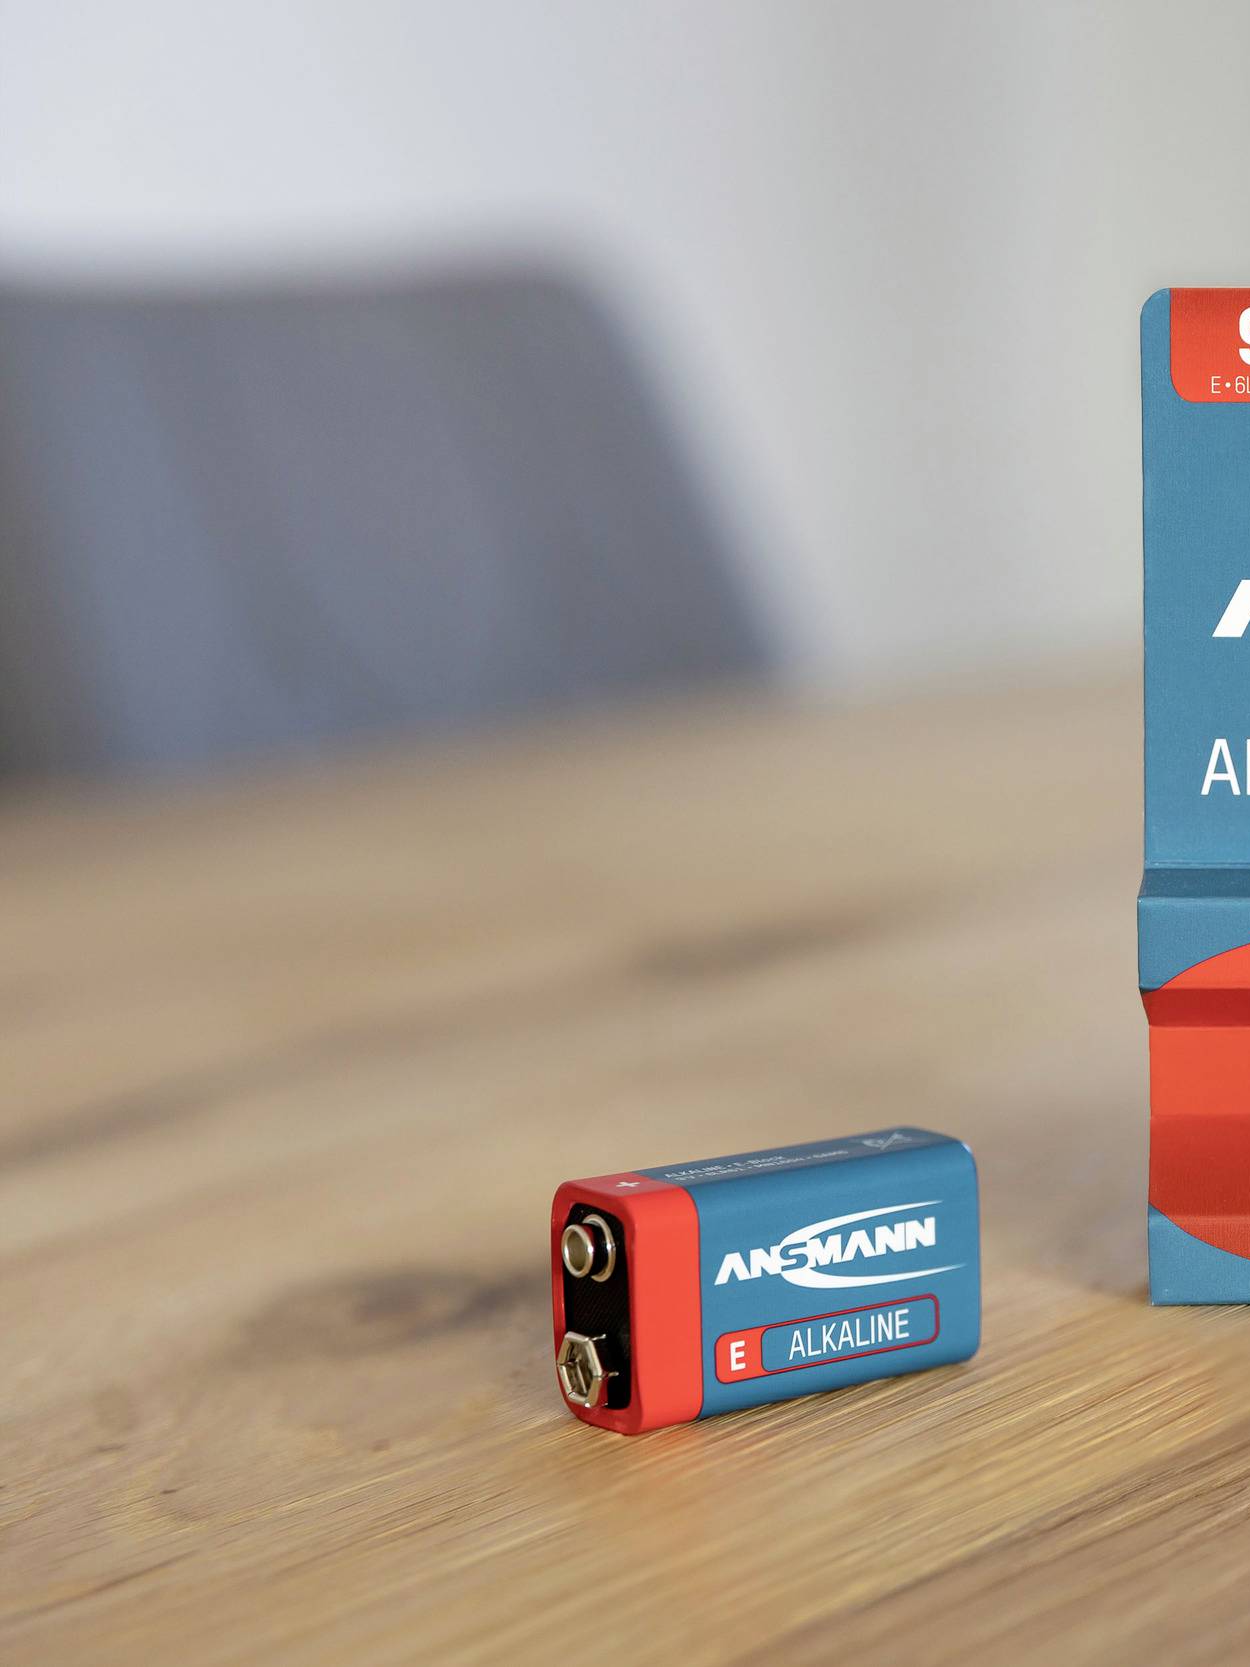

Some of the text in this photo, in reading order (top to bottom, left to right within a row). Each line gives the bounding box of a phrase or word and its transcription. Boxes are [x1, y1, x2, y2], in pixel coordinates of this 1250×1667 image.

[714, 1216, 936, 1286] ANSMANN
[729, 1307, 911, 1372] E ALKALINE
